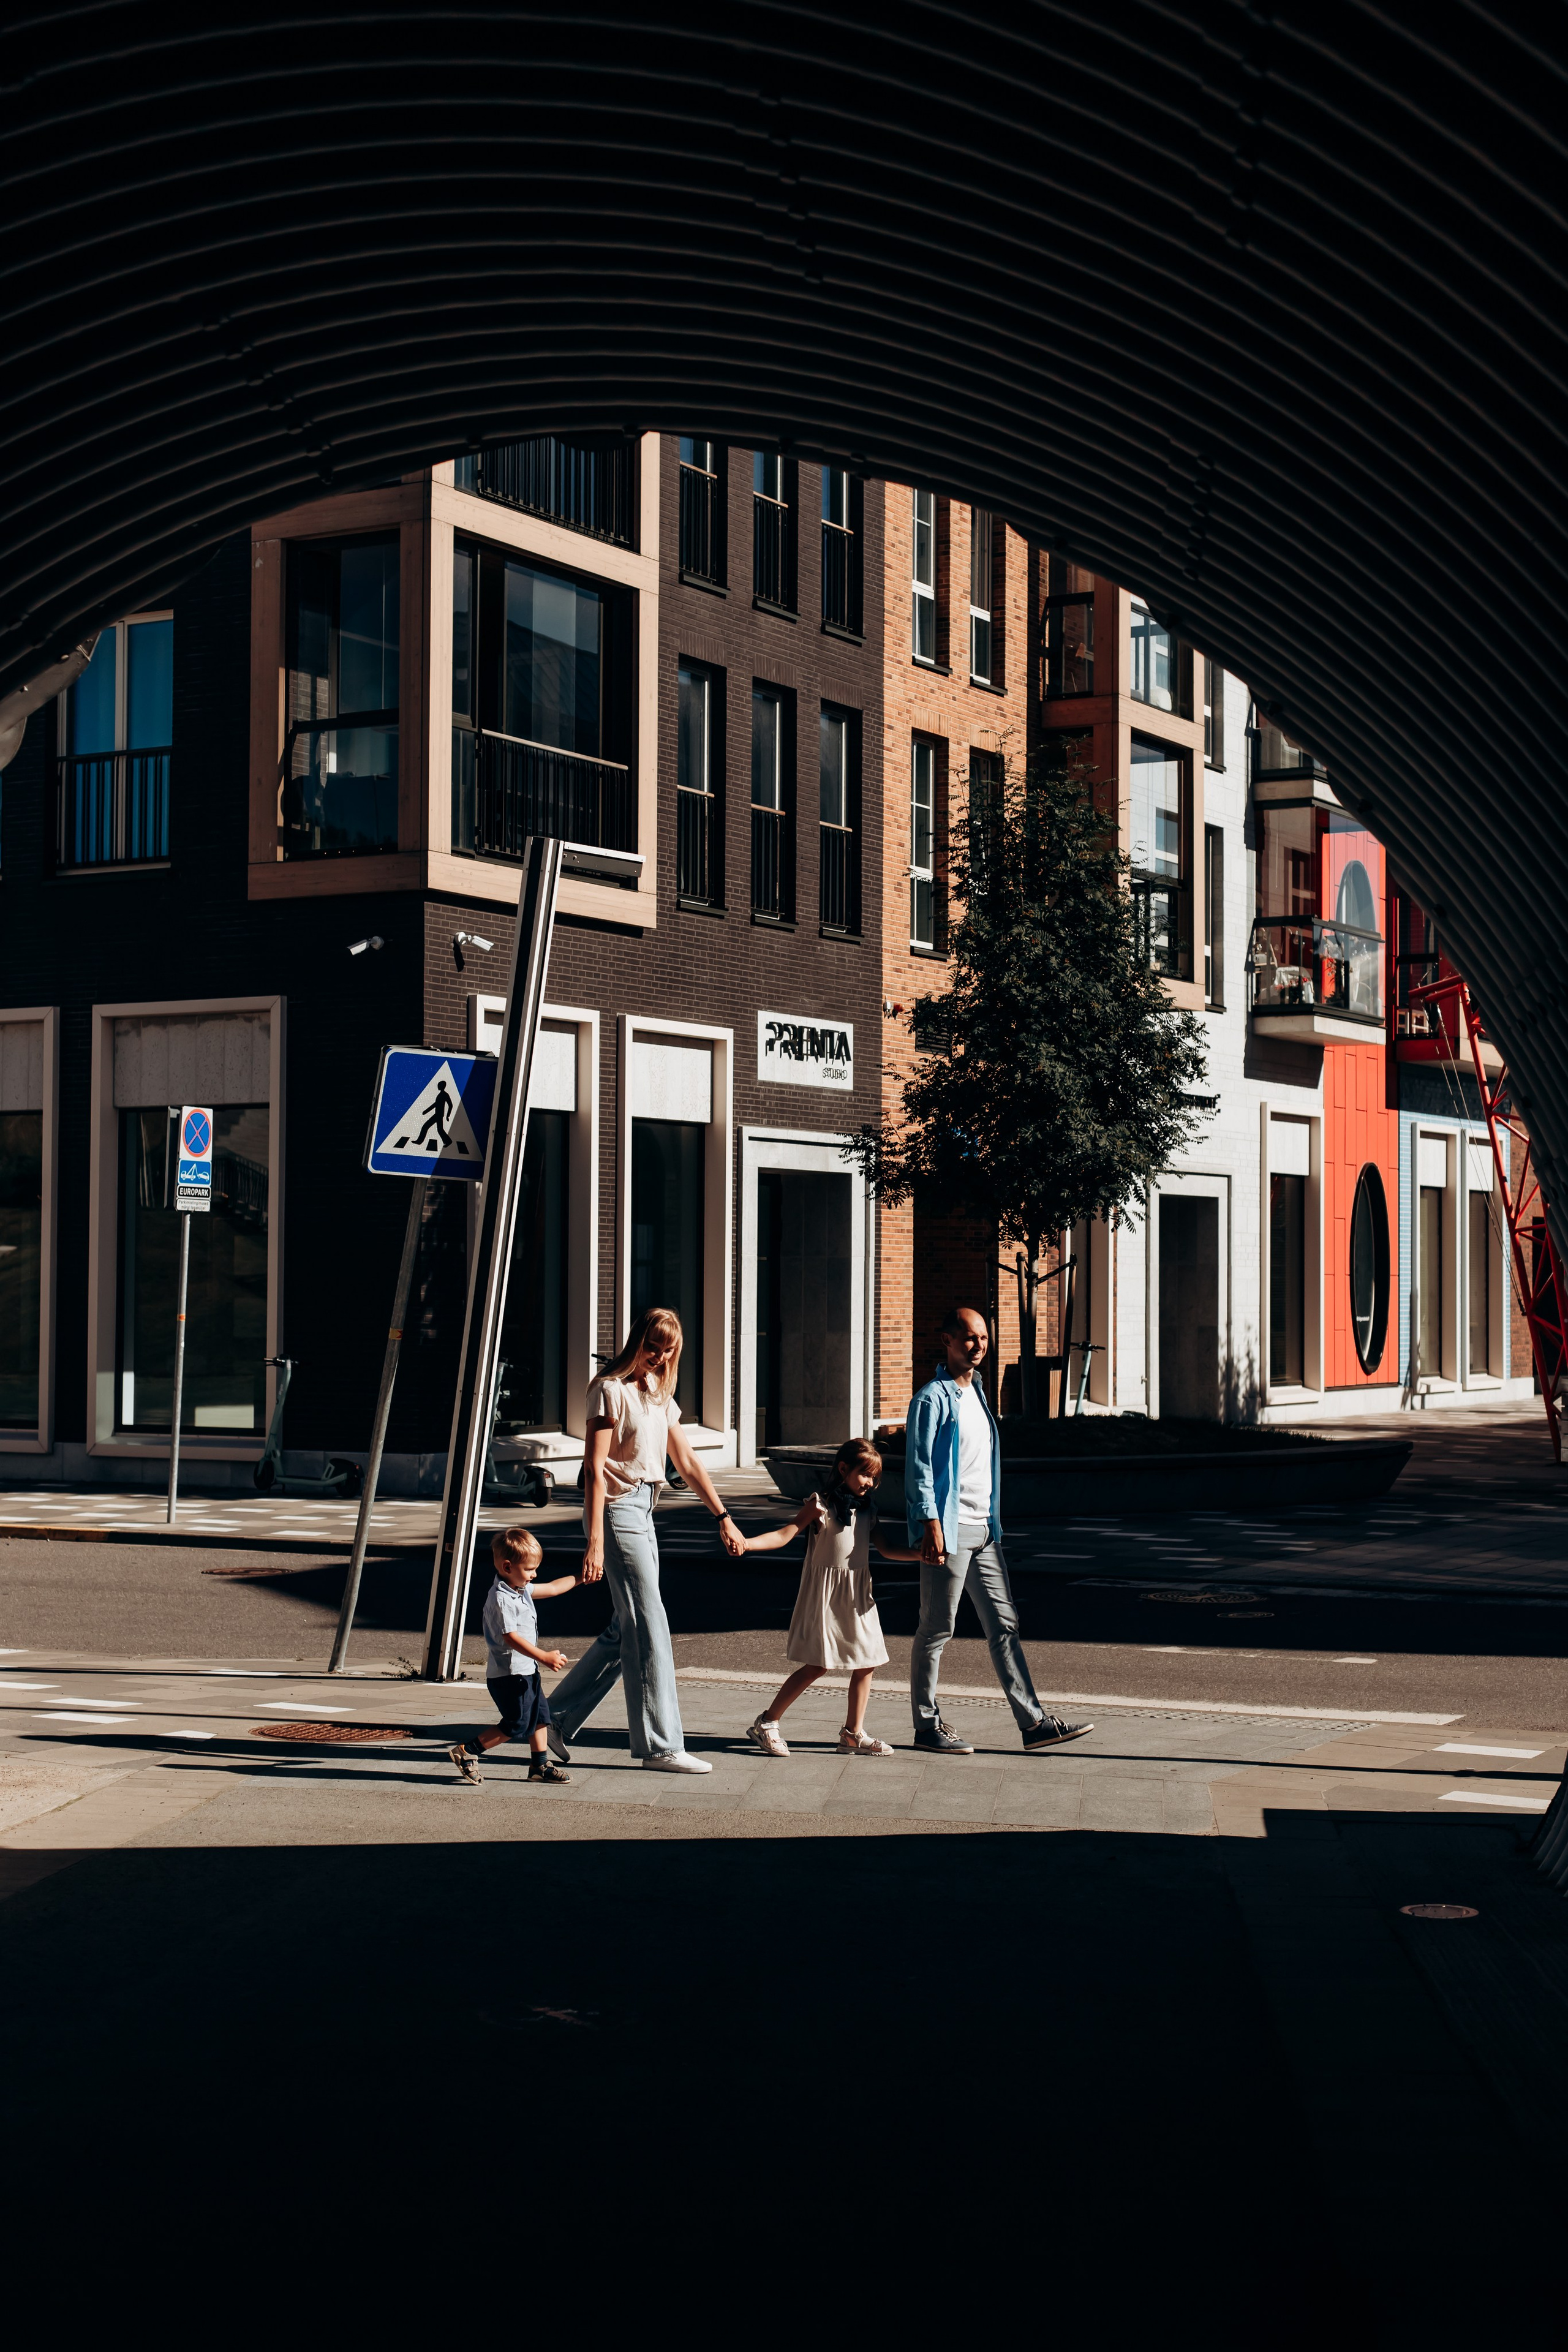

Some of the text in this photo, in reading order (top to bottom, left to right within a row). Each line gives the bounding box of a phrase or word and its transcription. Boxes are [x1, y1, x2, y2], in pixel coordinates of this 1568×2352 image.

[766, 1022, 851, 1066] PRENTA
[823, 1068, 847, 1080] STUDIO
[179, 1187, 208, 1196] EUROPARK
